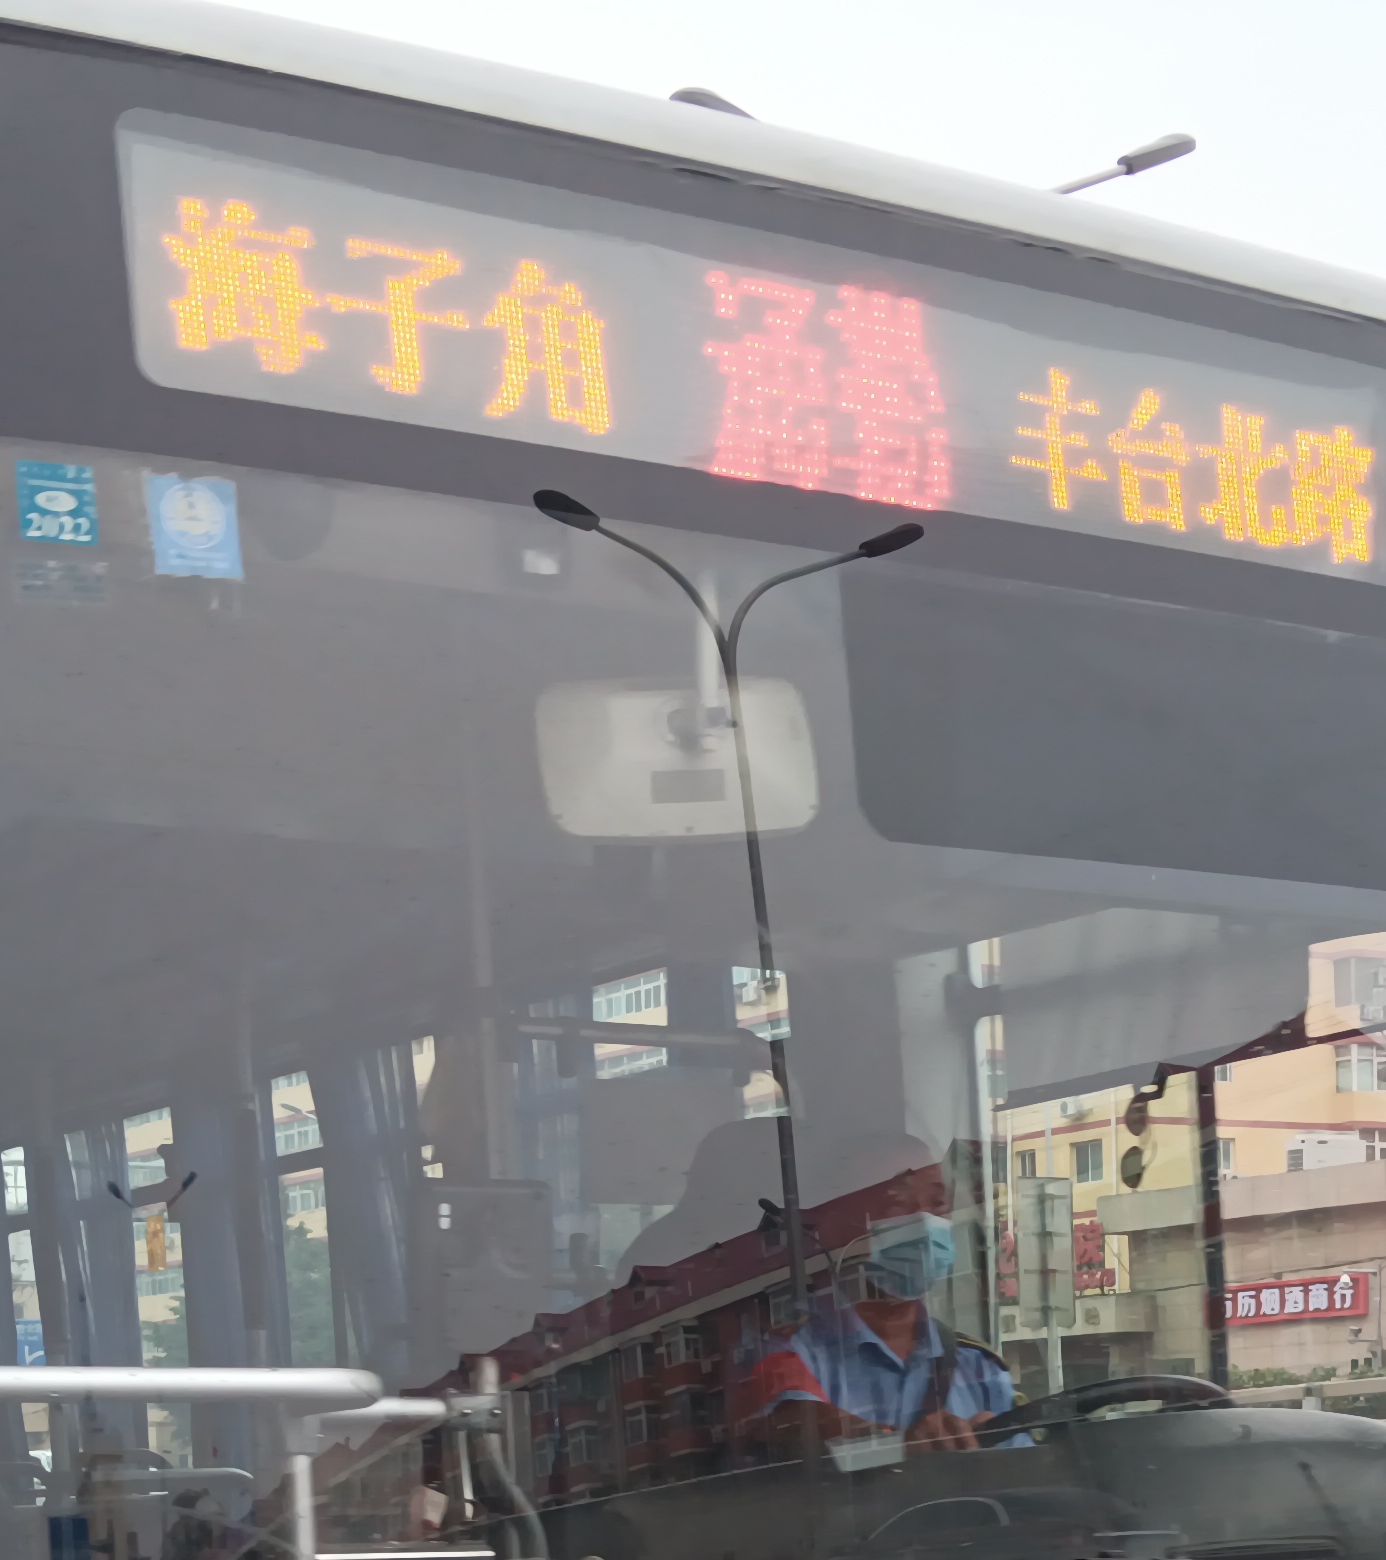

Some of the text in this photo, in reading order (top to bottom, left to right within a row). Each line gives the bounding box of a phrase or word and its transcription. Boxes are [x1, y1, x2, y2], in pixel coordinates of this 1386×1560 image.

[1009, 366, 1375, 565] 丰台北路
[26, 512, 92, 541] 2022
